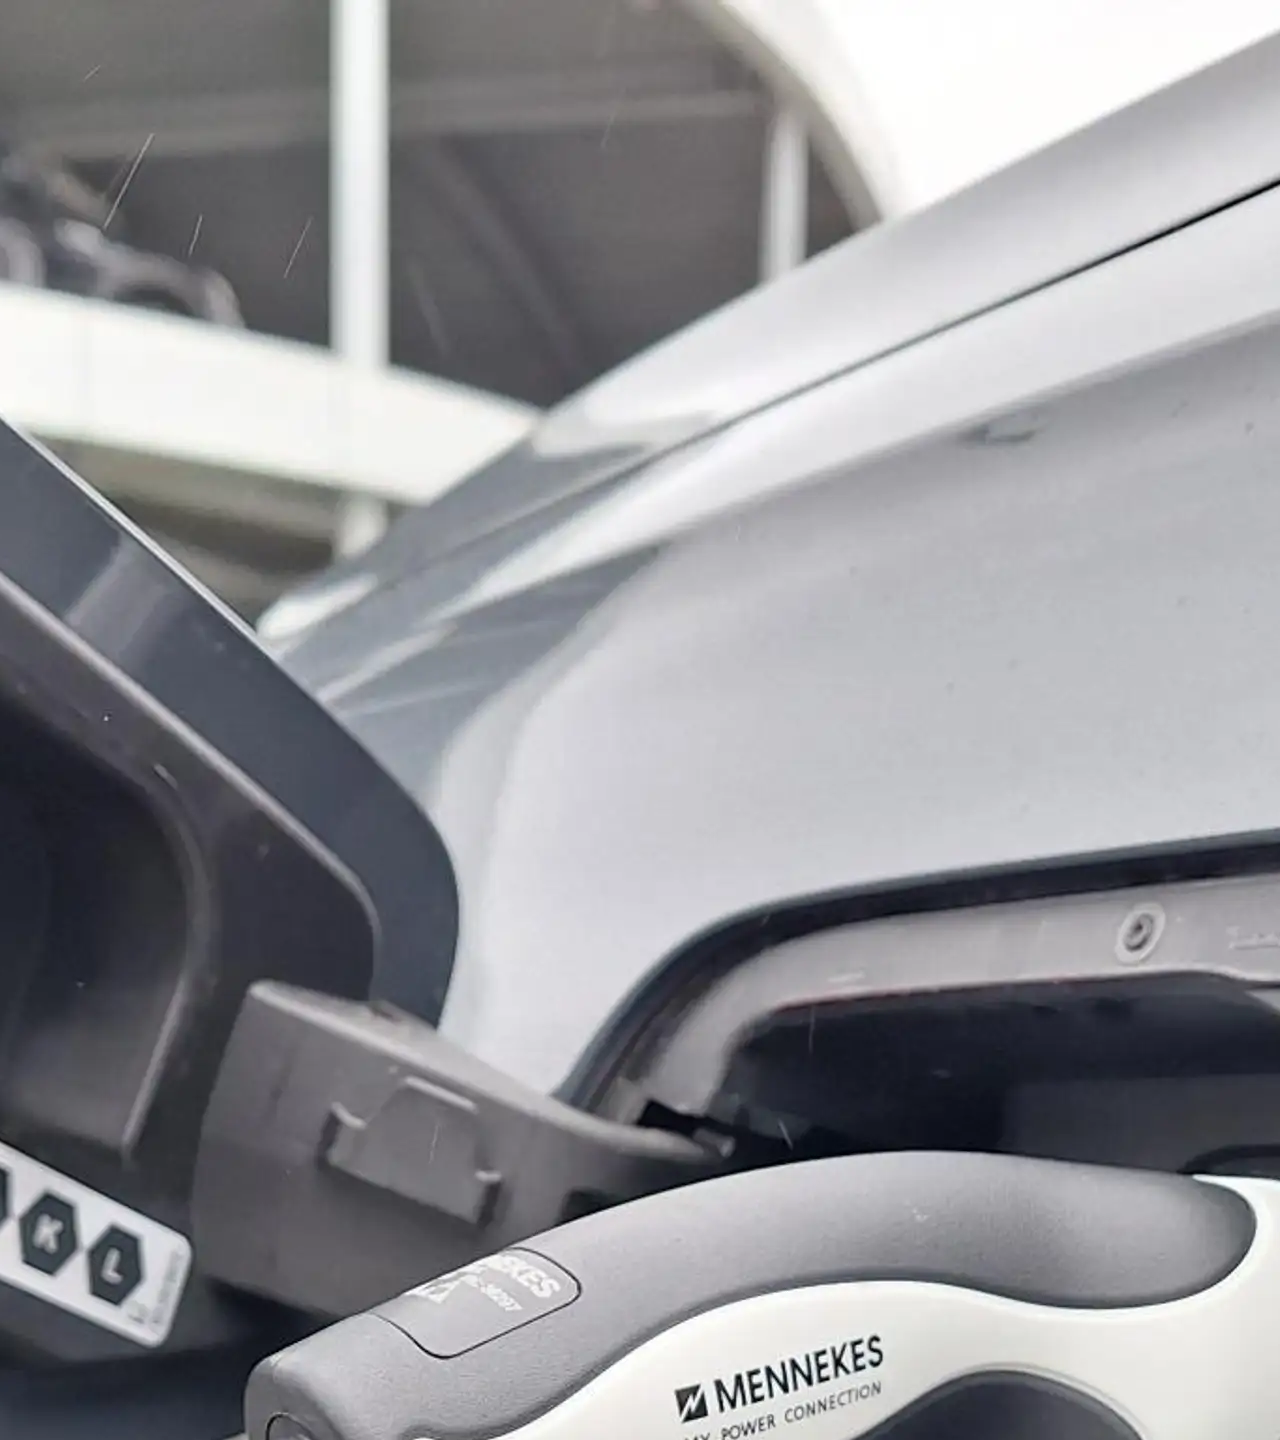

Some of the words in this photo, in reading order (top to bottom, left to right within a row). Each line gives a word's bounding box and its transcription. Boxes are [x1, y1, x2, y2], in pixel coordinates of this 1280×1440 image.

[32, 1213, 64, 1255] K
[100, 1248, 124, 1285] L
[713, 1333, 884, 1414] MENNEKES
[783, 1379, 883, 1424] CONNECTION
